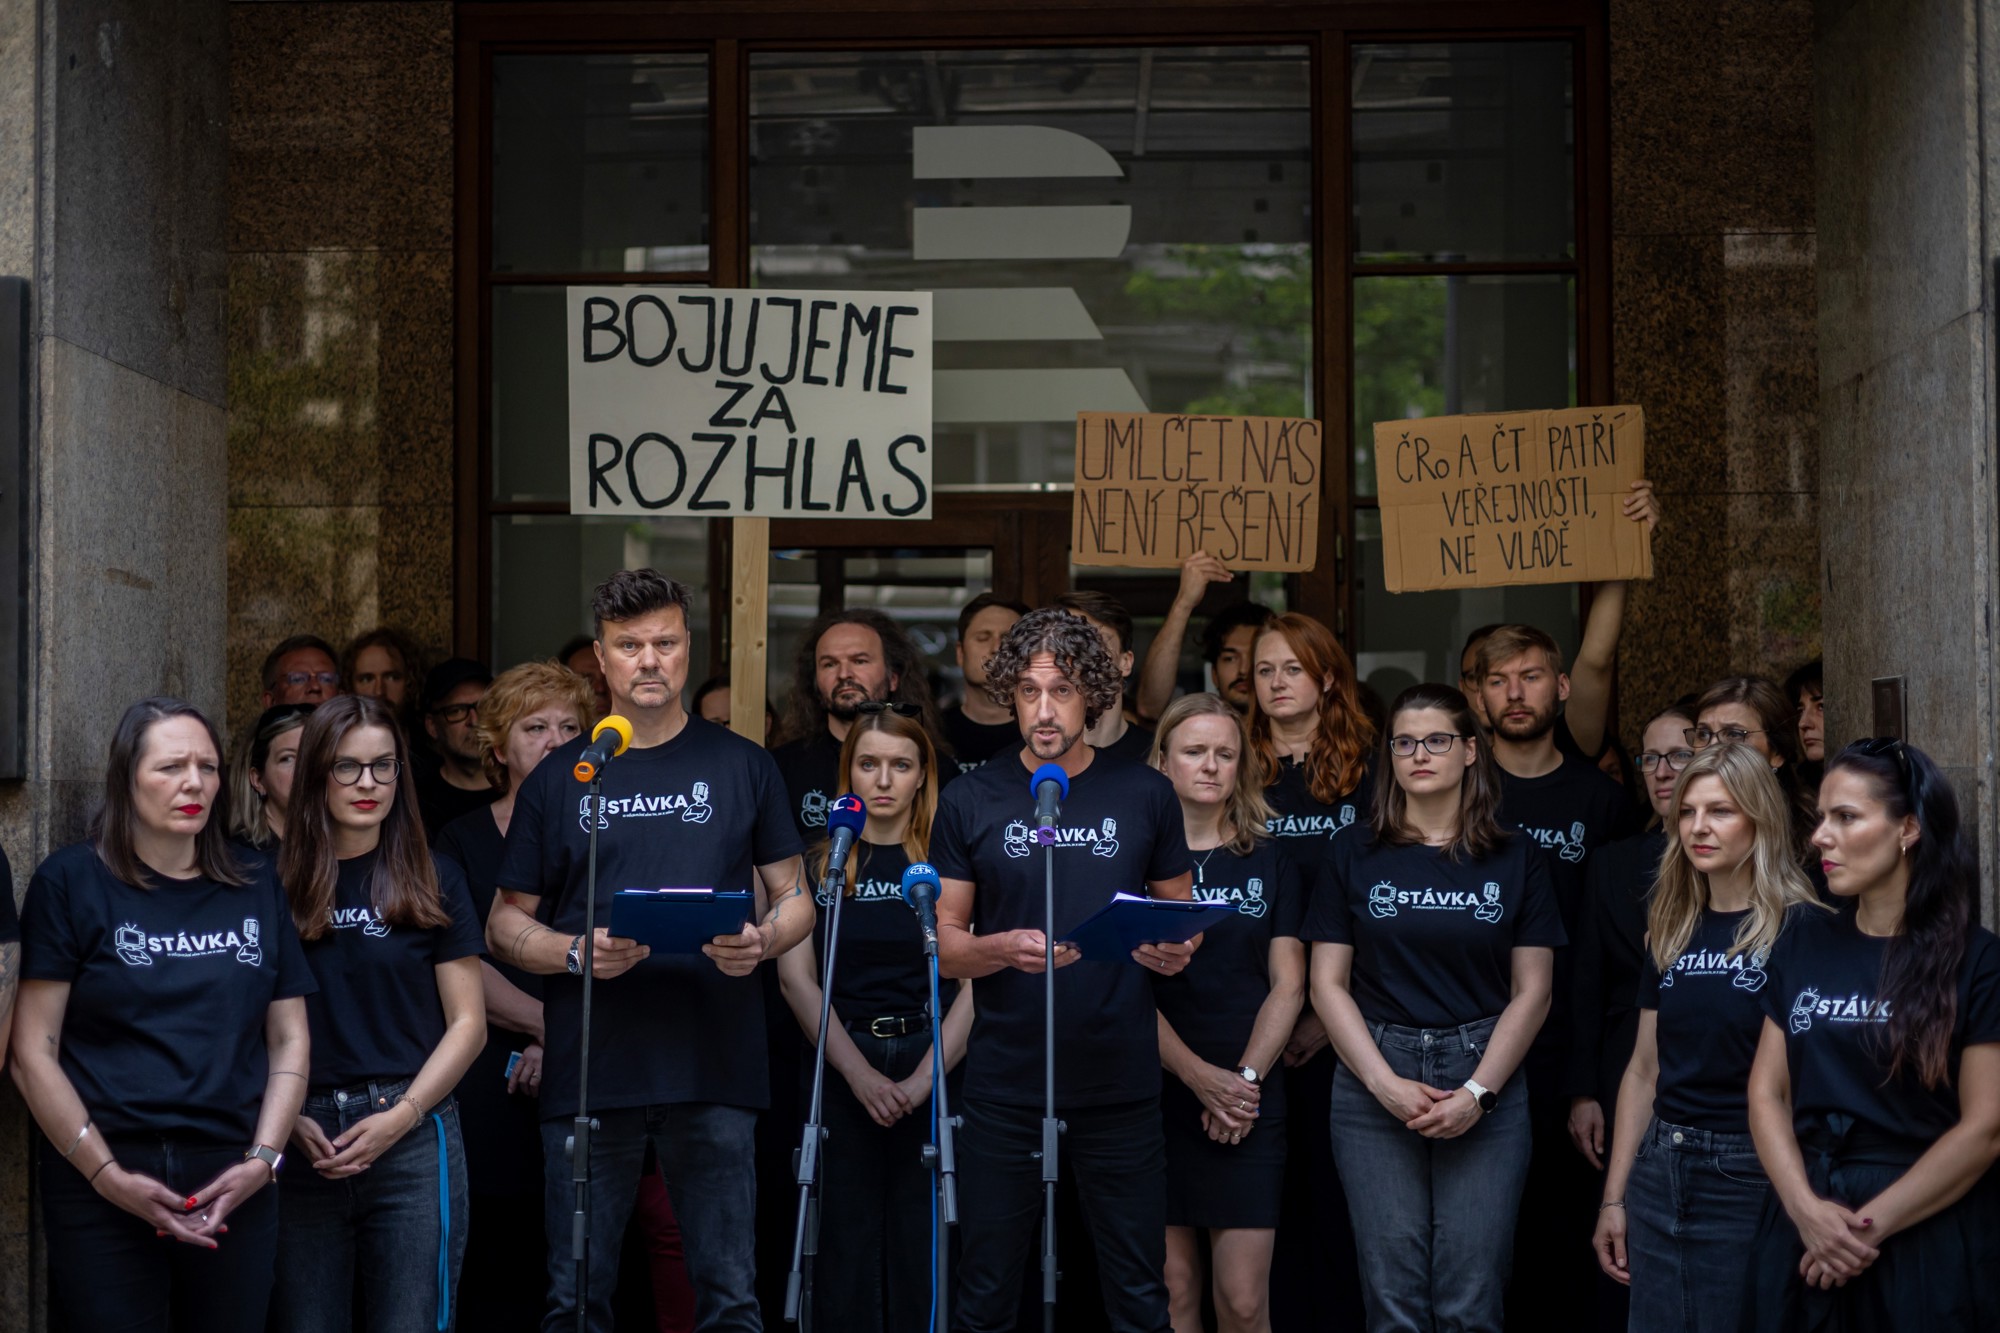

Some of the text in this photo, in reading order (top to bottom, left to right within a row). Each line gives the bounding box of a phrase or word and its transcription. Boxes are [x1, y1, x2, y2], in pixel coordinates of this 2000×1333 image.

[583, 294, 919, 394] BOJUJEME
[709, 380, 797, 433] ZA
[1081, 415, 1318, 486] UMLČET NÁS
[1458, 433, 1478, 478] A
[1491, 422, 1526, 473] ČT
[1547, 412, 1626, 472] PATŘÍ
[588, 432, 928, 517] ROZHLAS
[1441, 476, 1597, 527] VEŘEJNOSTI,
[1079, 482, 1312, 564] NENÍ ŘEŠENÍ
[1439, 520, 1573, 576] NE VLÁDĚ
[607, 793, 689, 815] STÁVKA
[1028, 823, 1099, 844] SÁVKA
[1265, 812, 1337, 834] STÁVKA
[855, 878, 904, 897] TÁVK
[1192, 885, 1244, 902] ÁVKA
[1397, 888, 1480, 906] STÁVKA
[333, 908, 371, 924] VKA
[147, 931, 241, 953] STÁVKA
[1676, 949, 1744, 971] STÁVKA
[1816, 994, 1893, 1017] STÁVK
